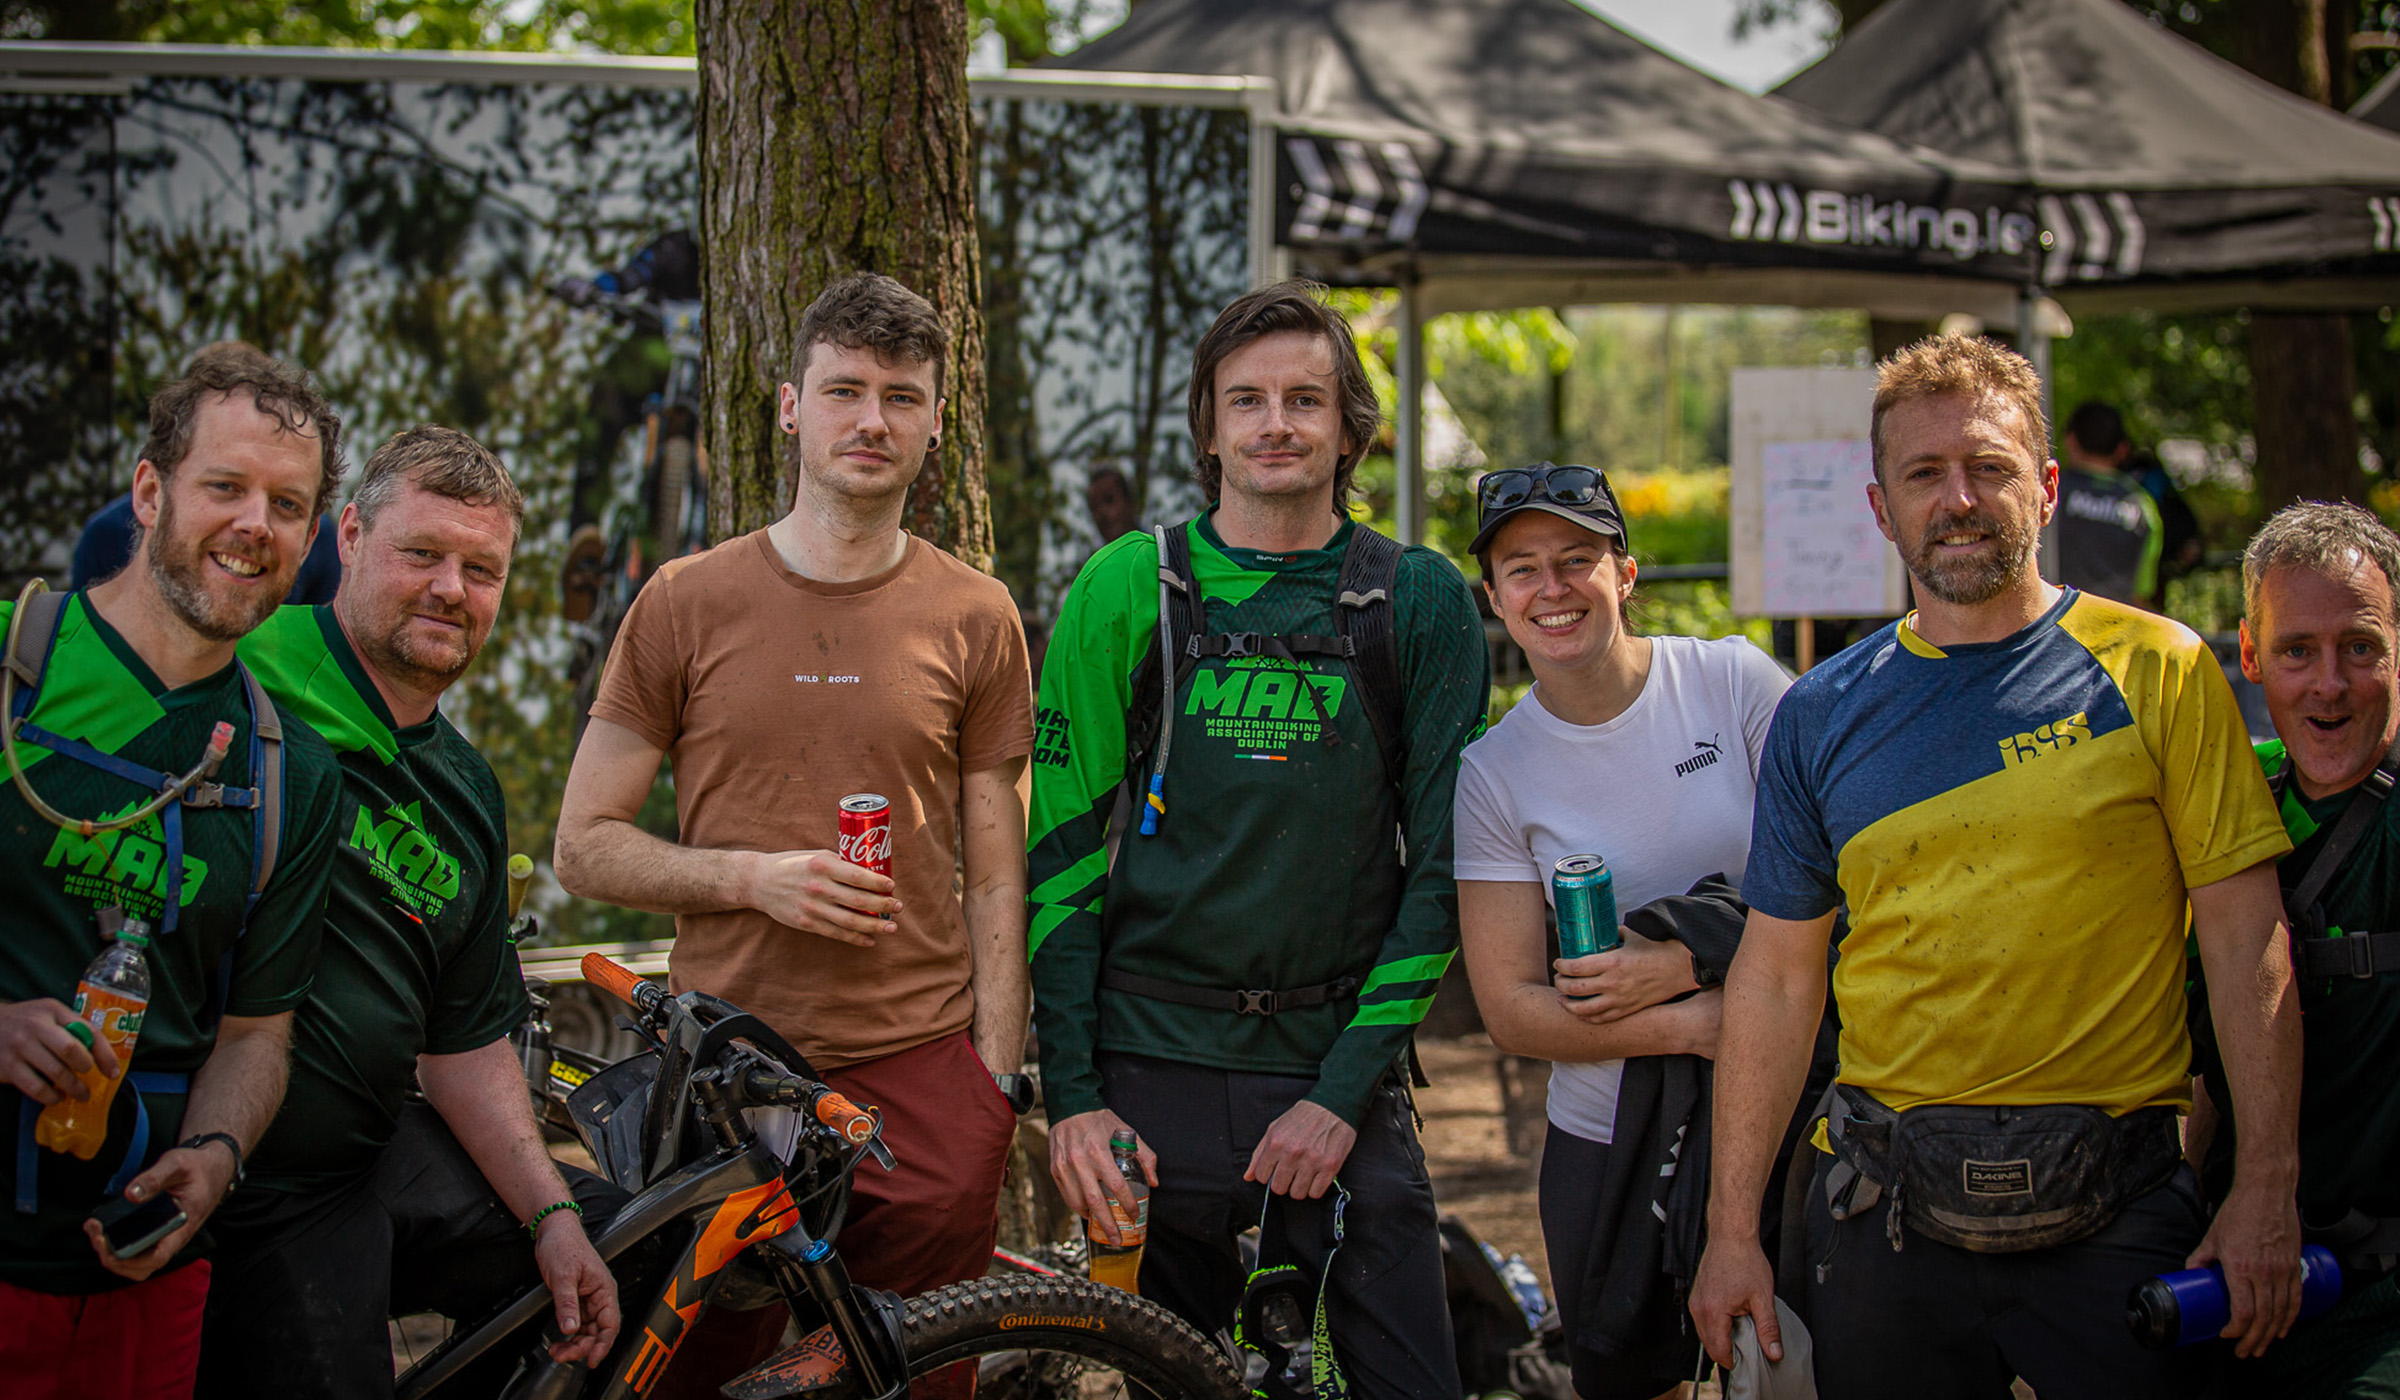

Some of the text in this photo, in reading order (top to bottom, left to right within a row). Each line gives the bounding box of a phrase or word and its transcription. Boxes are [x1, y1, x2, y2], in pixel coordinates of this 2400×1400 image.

[1805, 189, 2036, 260] Biking.ie
[794, 674, 860, 684] WILD ROOTS
[1184, 669, 1346, 721] MAD
[1205, 718, 1322, 732] MOUNTAINBIKING
[1207, 727, 1320, 742] ASSOCIATION OF
[1237, 738, 1288, 750] DUBLIN
[1674, 749, 1719, 778] PUMA
[42, 824, 210, 908] MAD
[348, 803, 461, 901] MAD
[64, 873, 166, 911] MOUNTAINBIKIN
[999, 1312, 1094, 1331] Continental
